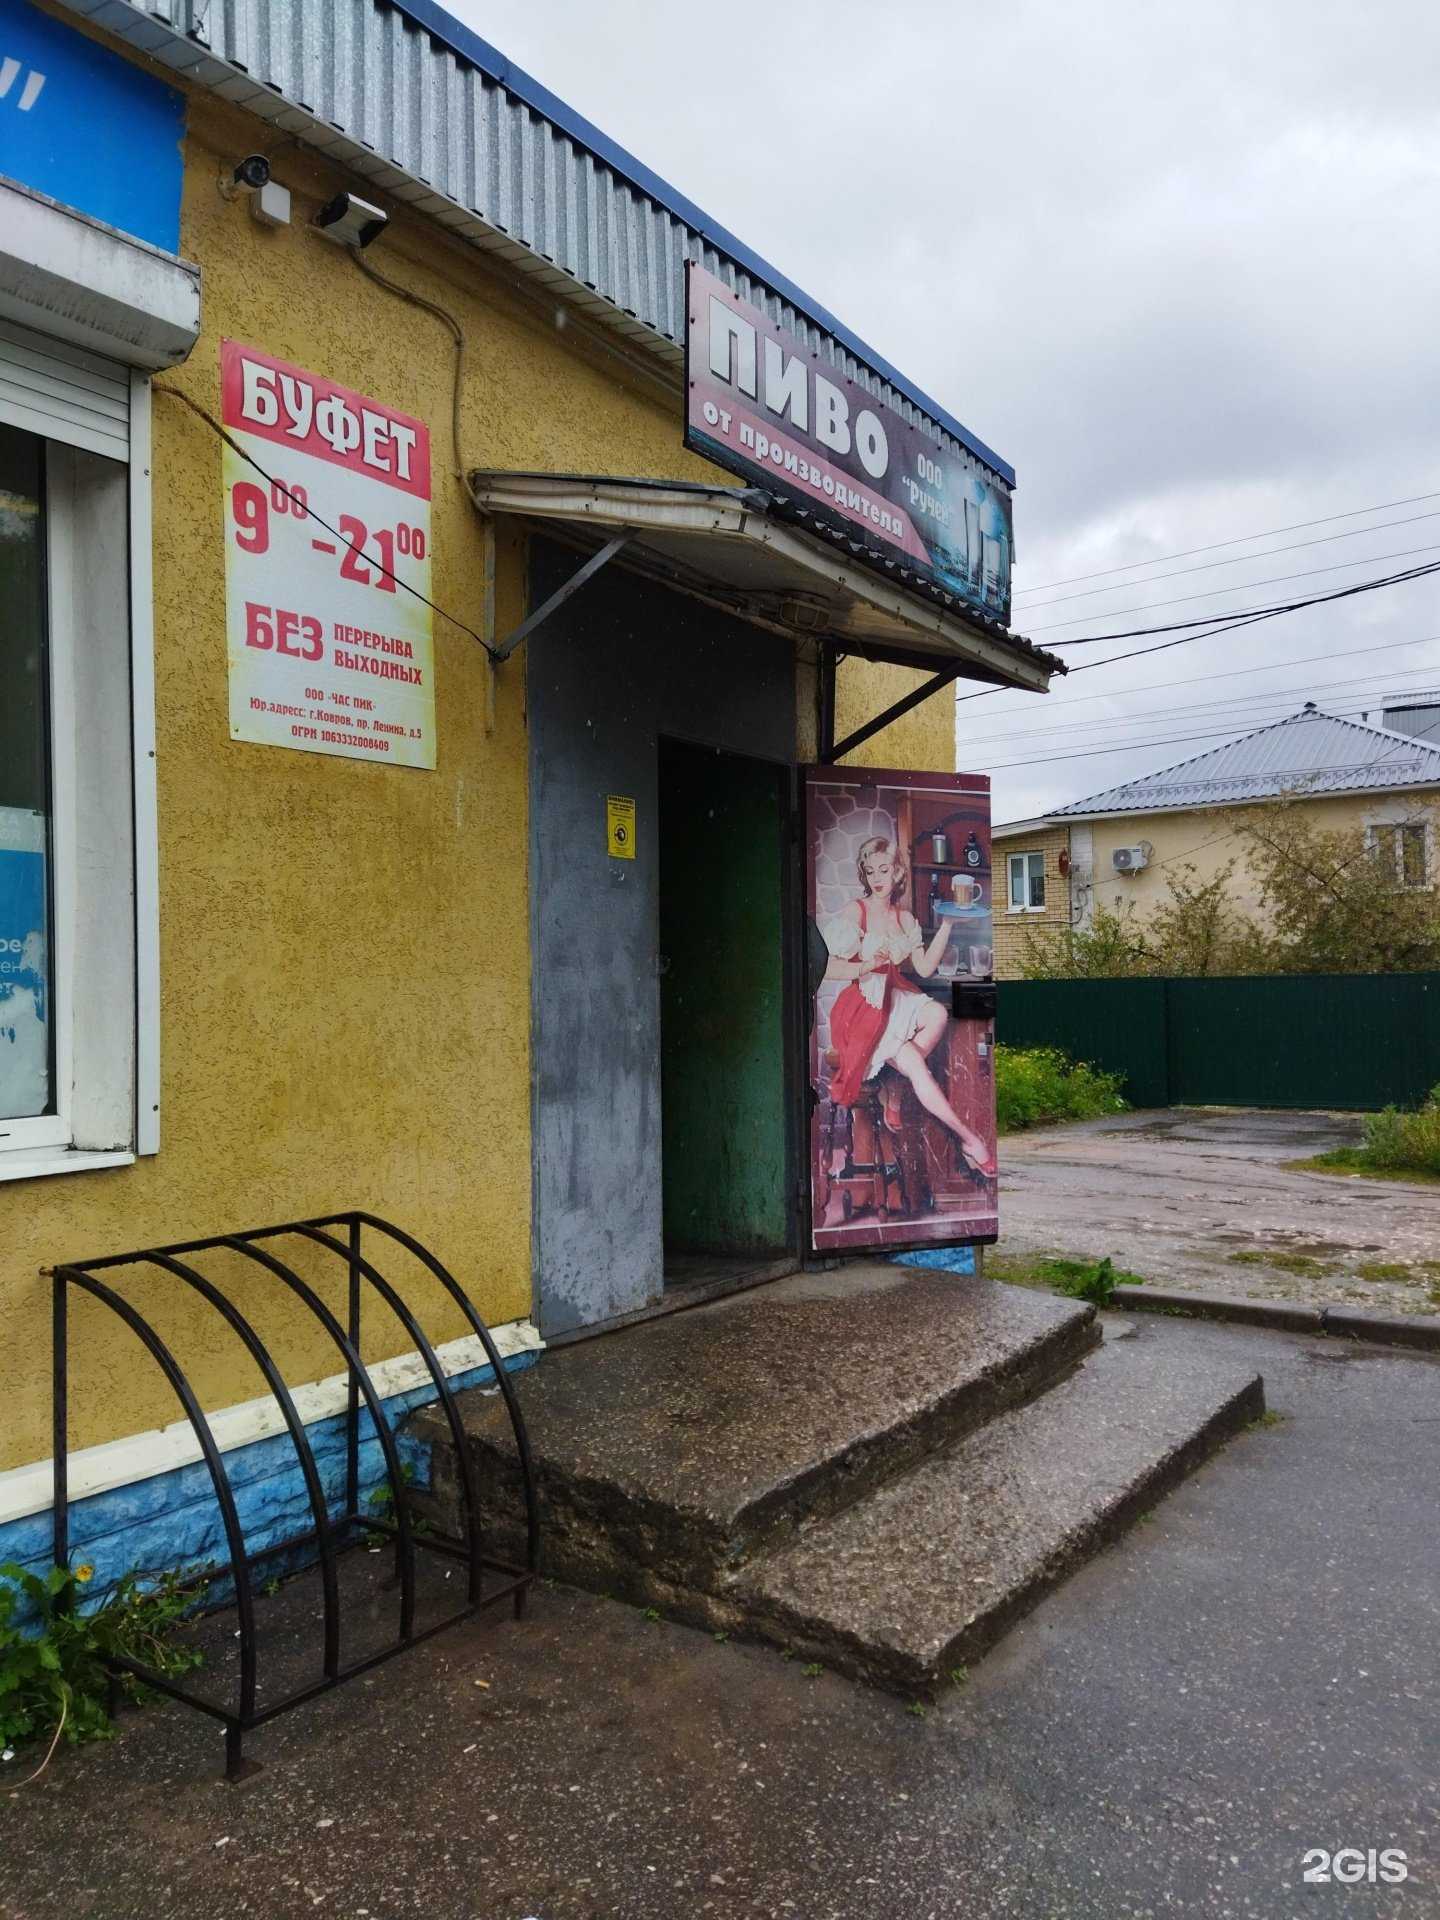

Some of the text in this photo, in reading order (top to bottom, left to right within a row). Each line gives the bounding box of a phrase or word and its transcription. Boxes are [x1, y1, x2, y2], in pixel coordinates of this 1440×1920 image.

[241, 358, 416, 481] БУФЕТ
[709, 294, 888, 479] ПИВО
[703, 401, 904, 538] от производителя
[917, 453, 942, 490] ООО
[245, 601, 414, 662] БЕЗ ПЕРЕРЫВА
[334, 649, 423, 685] ВЫХОДНЫХ
